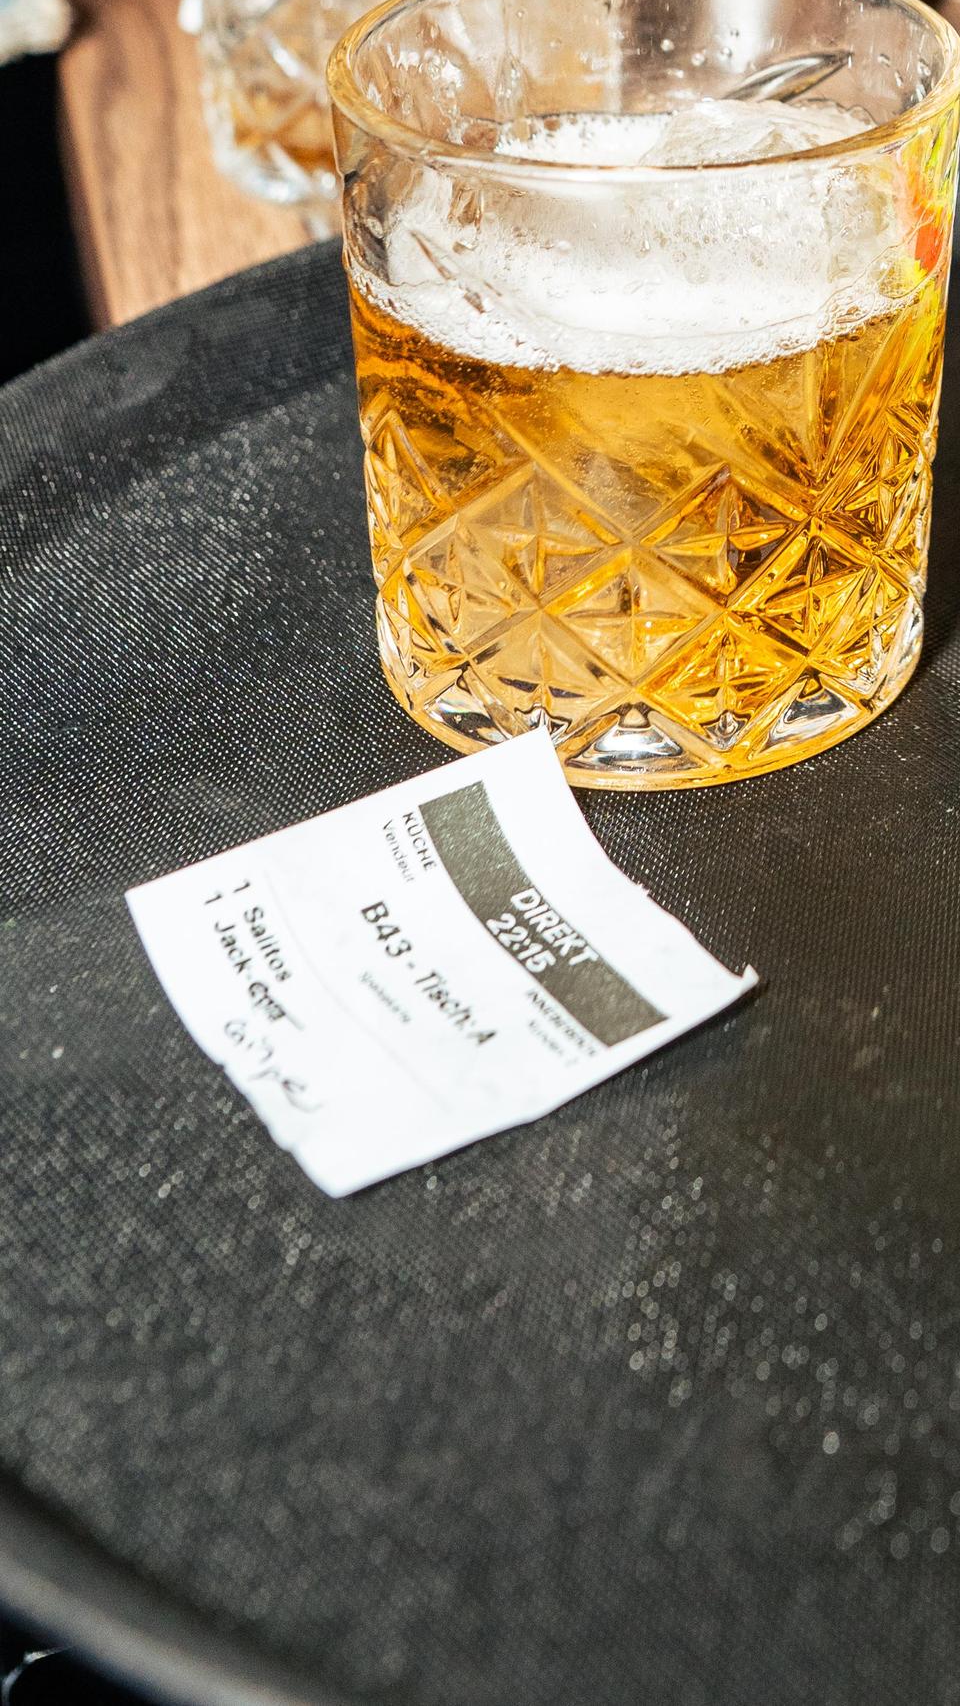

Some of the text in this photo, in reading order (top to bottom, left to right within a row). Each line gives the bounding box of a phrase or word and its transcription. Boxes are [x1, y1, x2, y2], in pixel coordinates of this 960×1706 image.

[203, 891, 224, 906] 1
[361, 900, 413, 959] B43
[510, 887, 600, 967] DIREKT
[232, 879, 293, 982] 1 Salitos
[485, 912, 557, 974] 22:15
